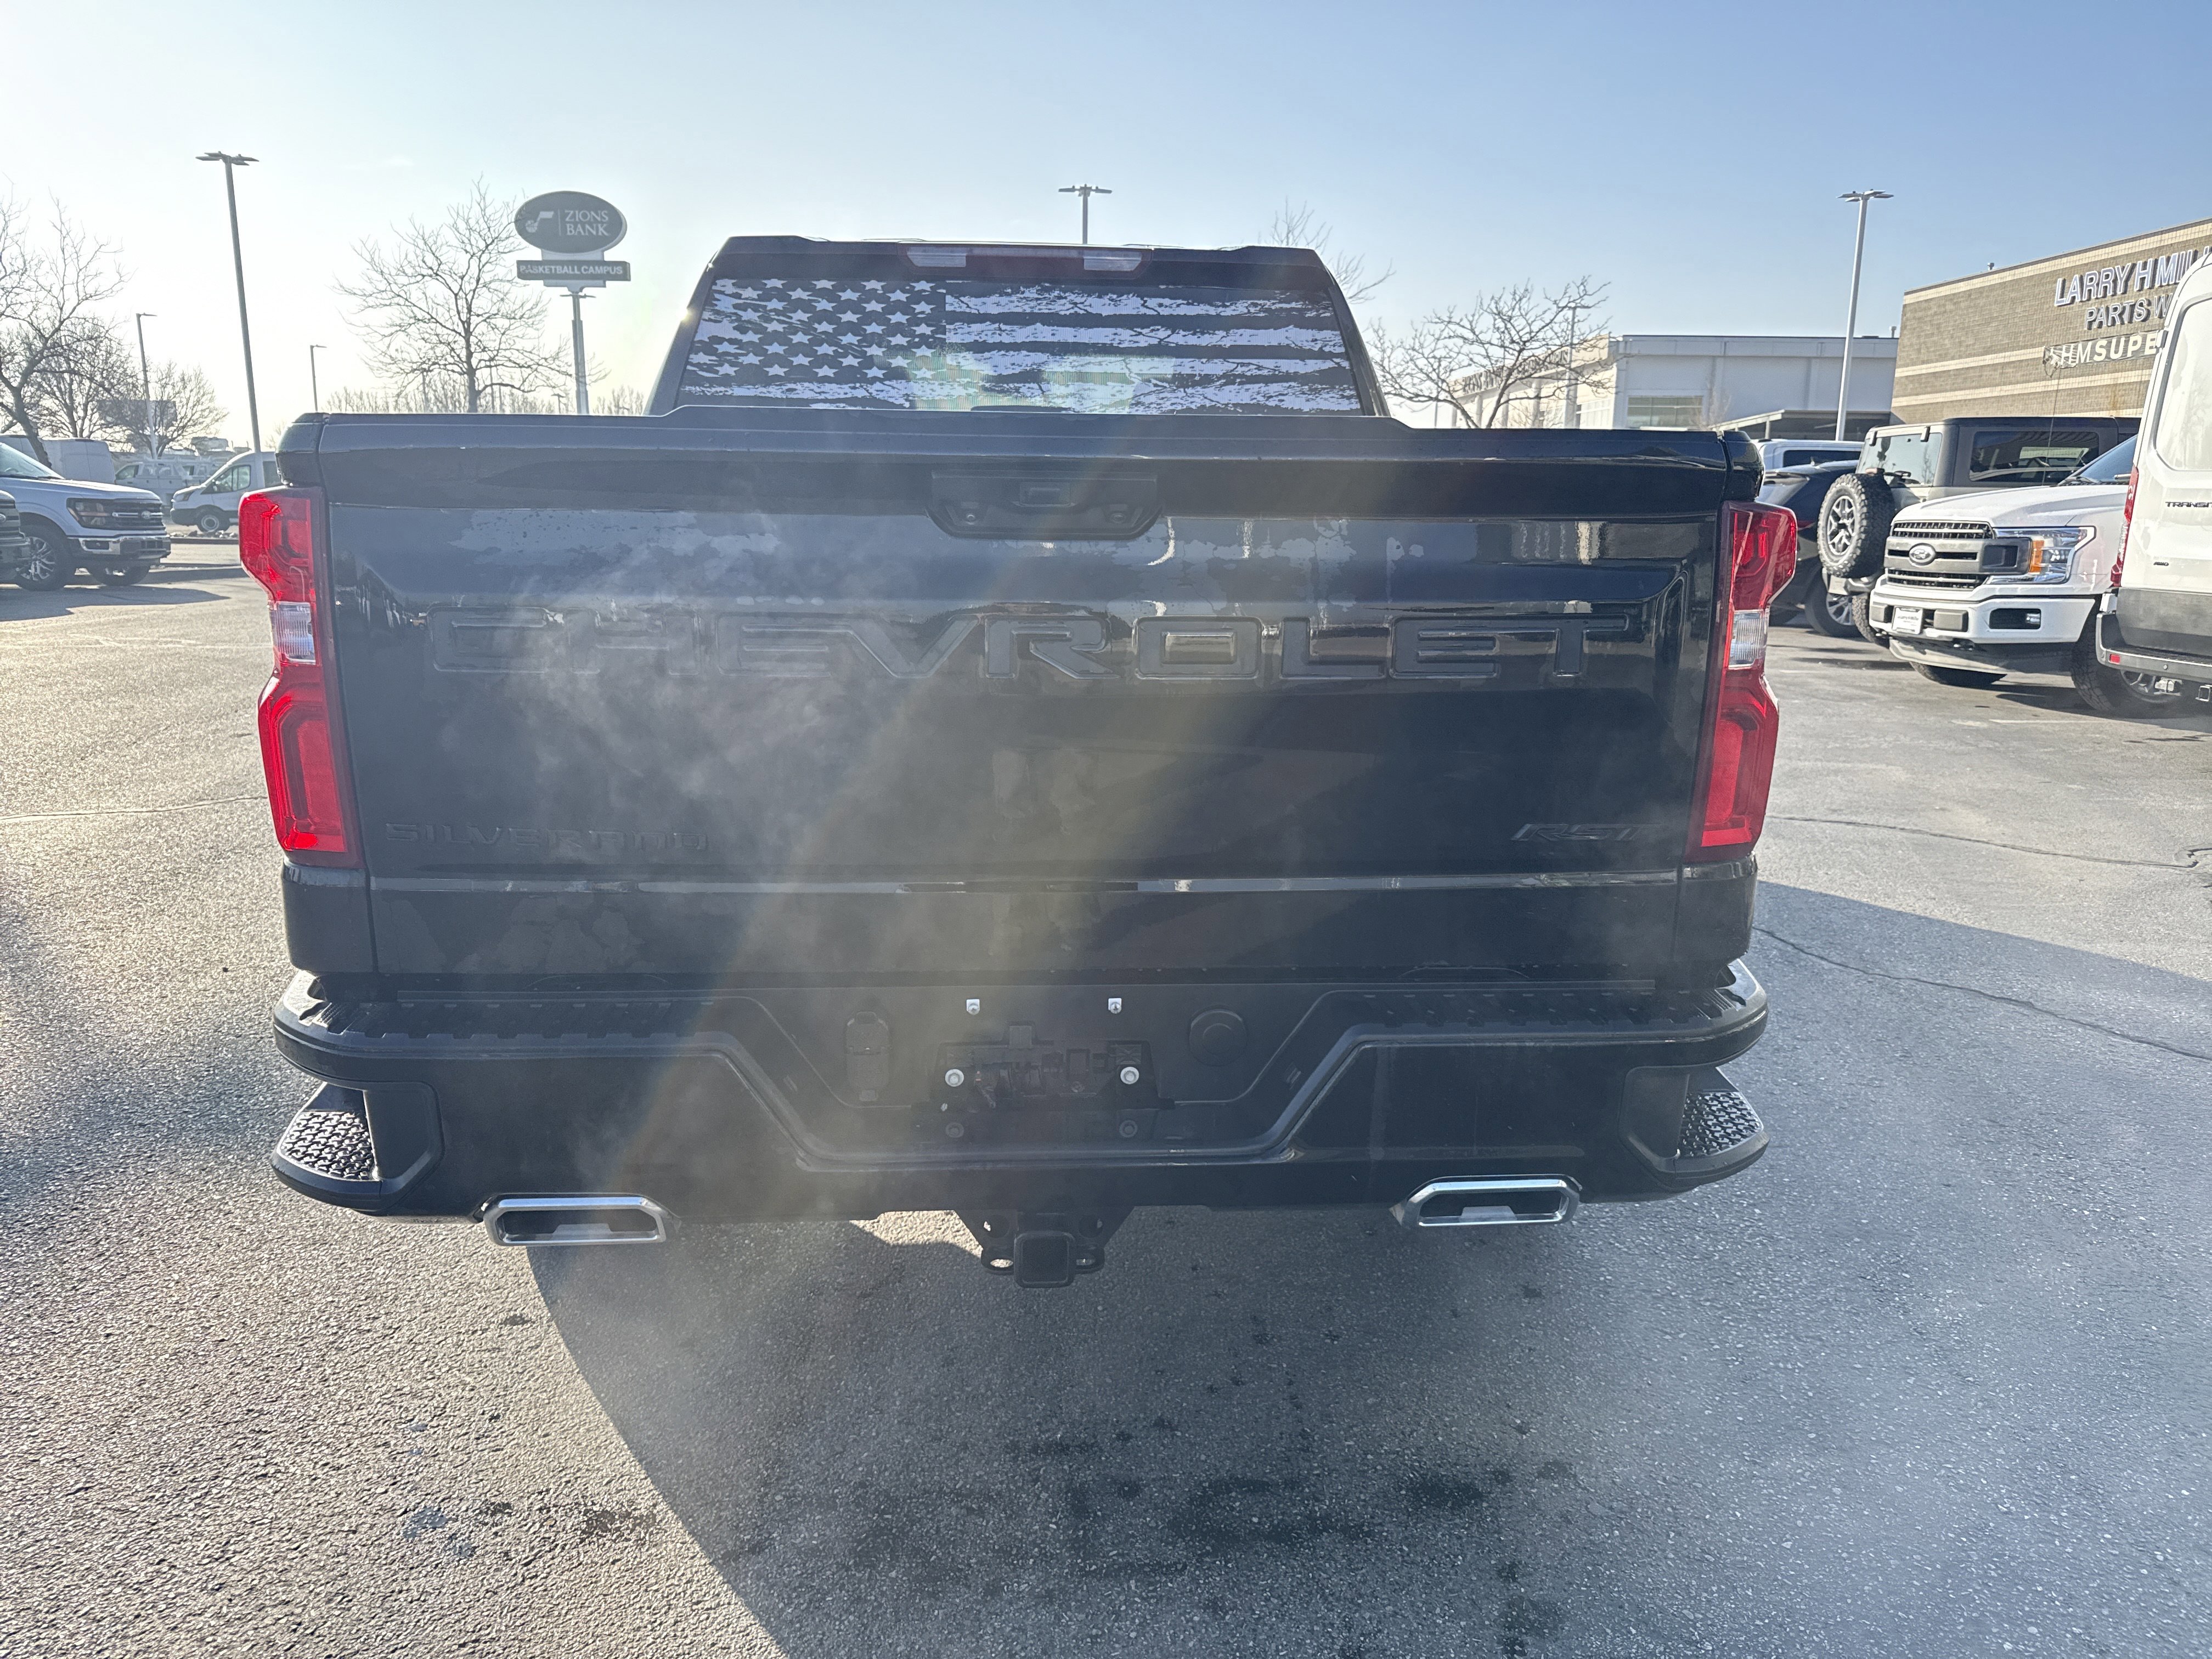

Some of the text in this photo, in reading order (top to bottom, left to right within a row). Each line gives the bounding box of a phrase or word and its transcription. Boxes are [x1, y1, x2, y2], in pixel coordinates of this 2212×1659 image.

[565, 210, 608, 222] ZIONS
[566, 223, 610, 236] BANK
[582, 266, 623, 274] CAMPUS
[2054, 262, 2132, 306] LARRY
[2134, 258, 2153, 292] H
[2085, 298, 2147, 330] PARTS
[429, 605, 1629, 680] CHEVROLET
[385, 822, 709, 851] SILVERADO
[1510, 822, 1660, 842] RST
